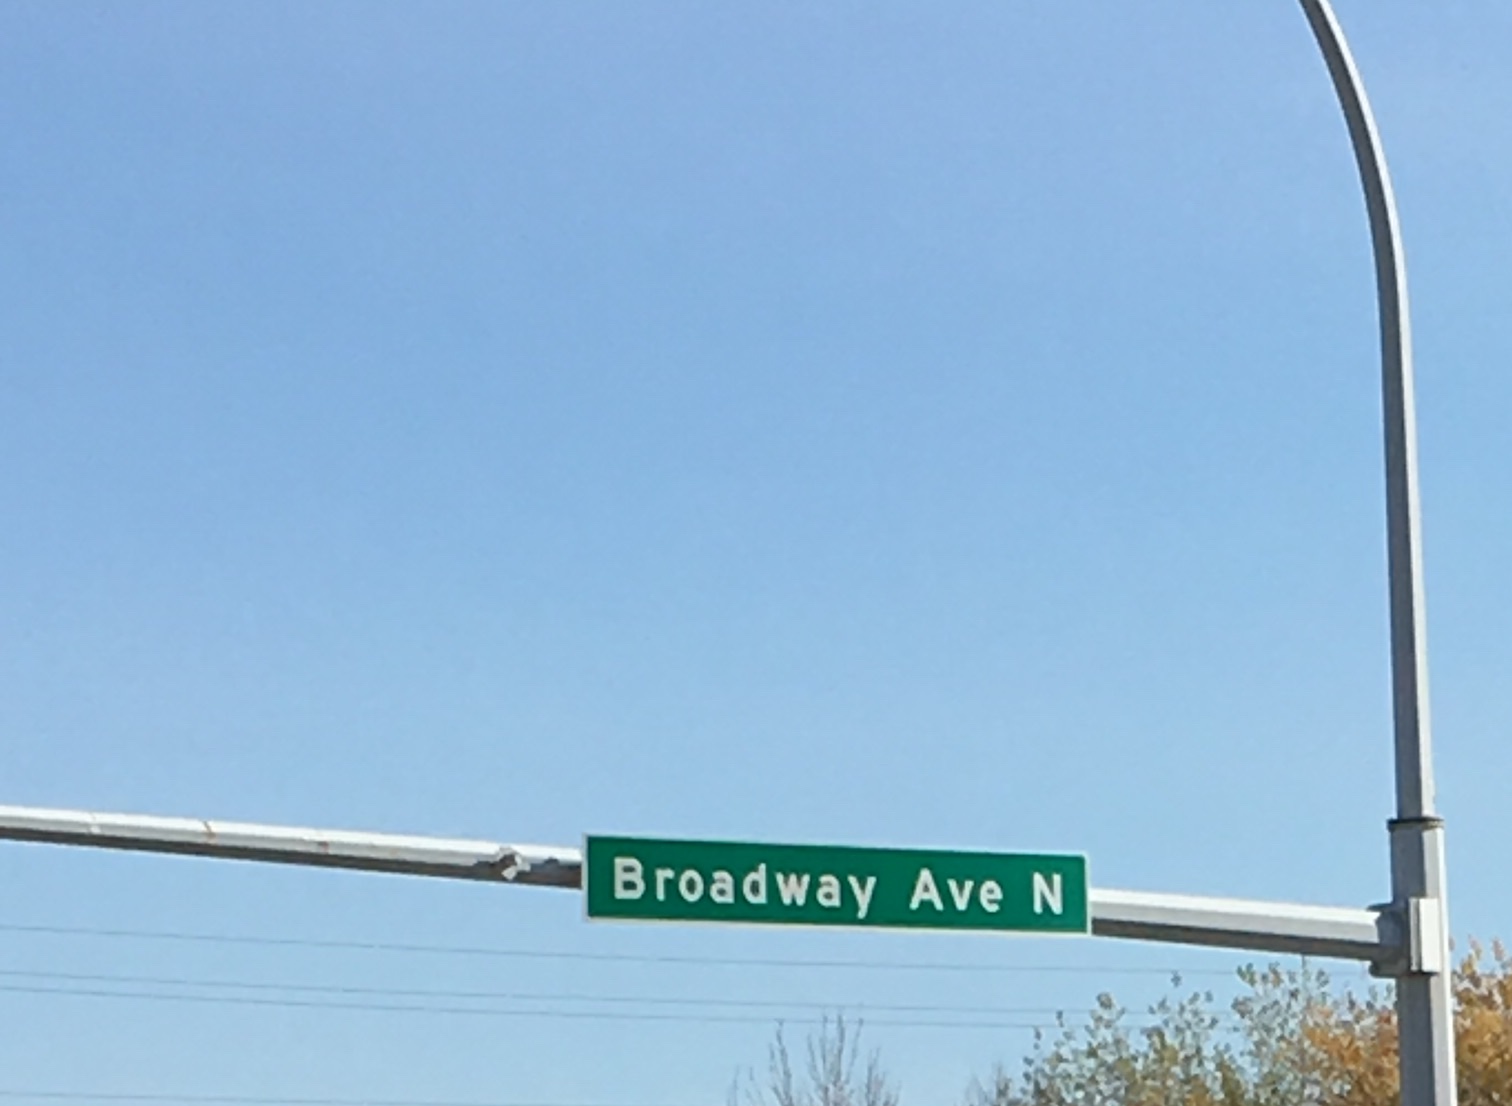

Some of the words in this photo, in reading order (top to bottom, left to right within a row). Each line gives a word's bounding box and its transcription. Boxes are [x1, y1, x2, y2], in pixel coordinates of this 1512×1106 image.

[613, 856, 876, 918] Broadway
[909, 867, 1003, 913] Ave
[1032, 871, 1062, 915] N
